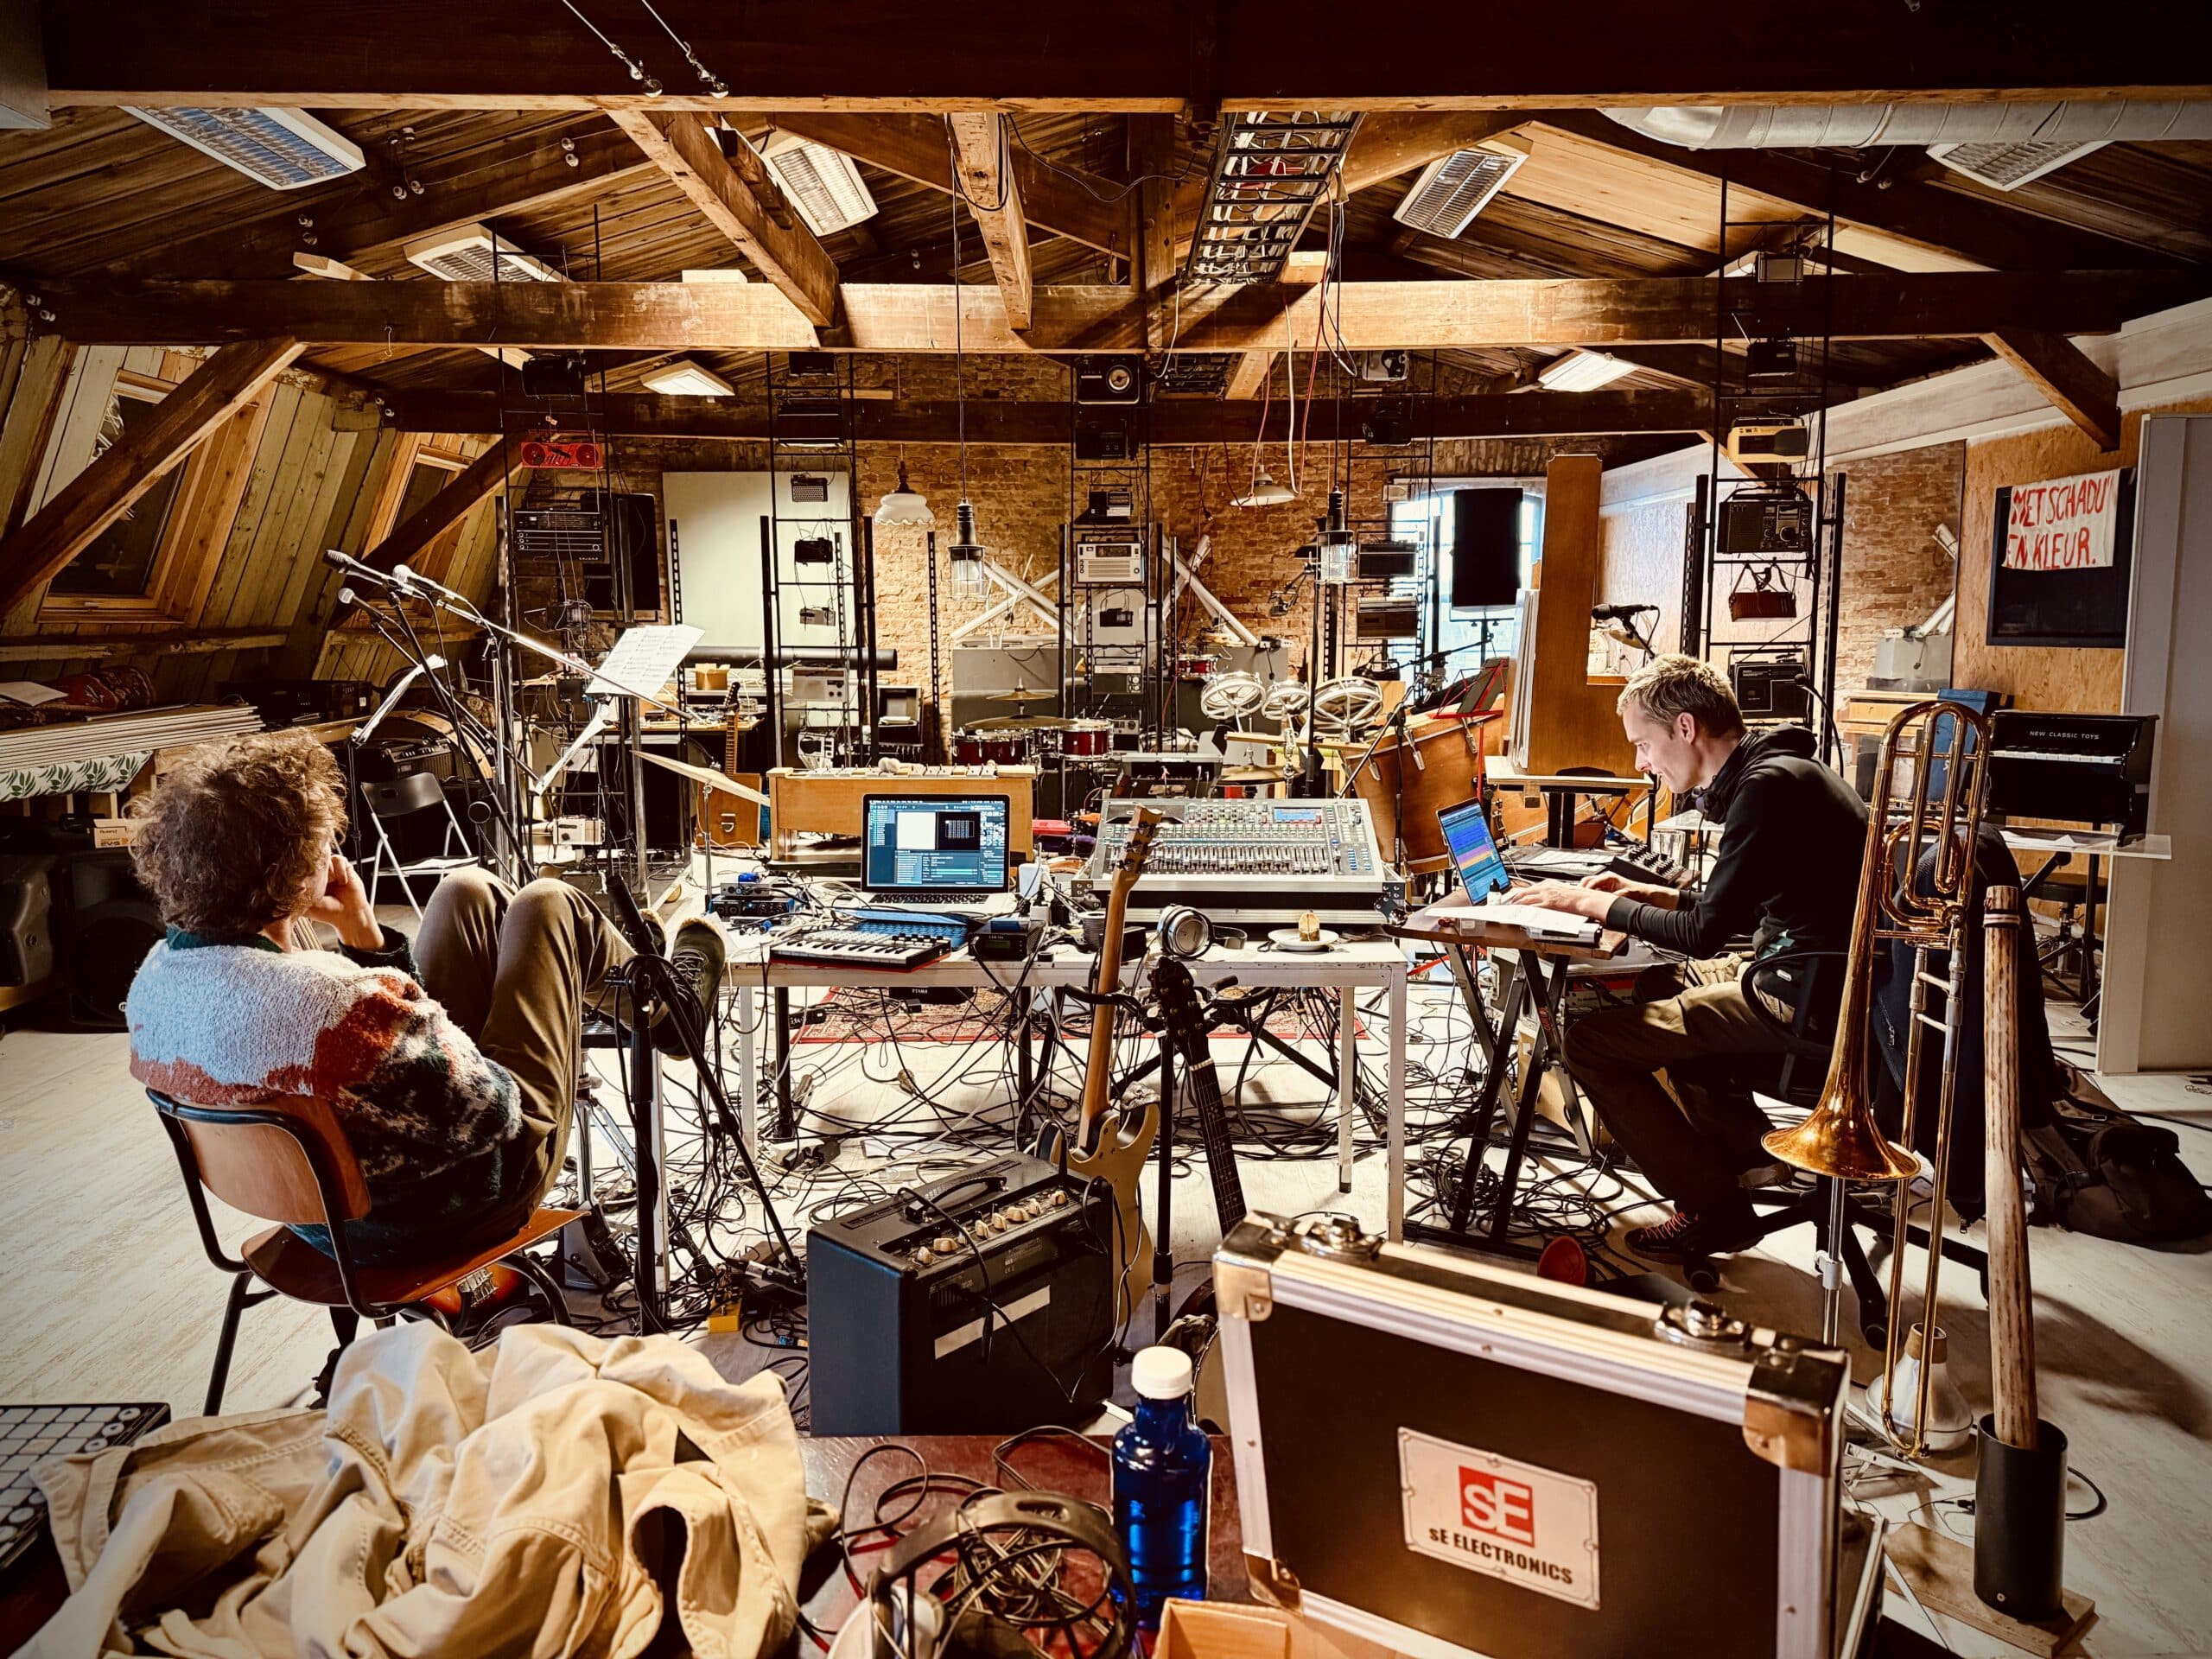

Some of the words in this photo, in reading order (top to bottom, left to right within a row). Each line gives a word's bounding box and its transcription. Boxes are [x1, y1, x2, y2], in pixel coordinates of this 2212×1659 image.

[2011, 487, 2046, 527] MET
[2006, 533, 2029, 569] EN
[2031, 526, 2097, 570] KLEUR.
[1453, 1532, 1573, 1586] ELECTRONICS
